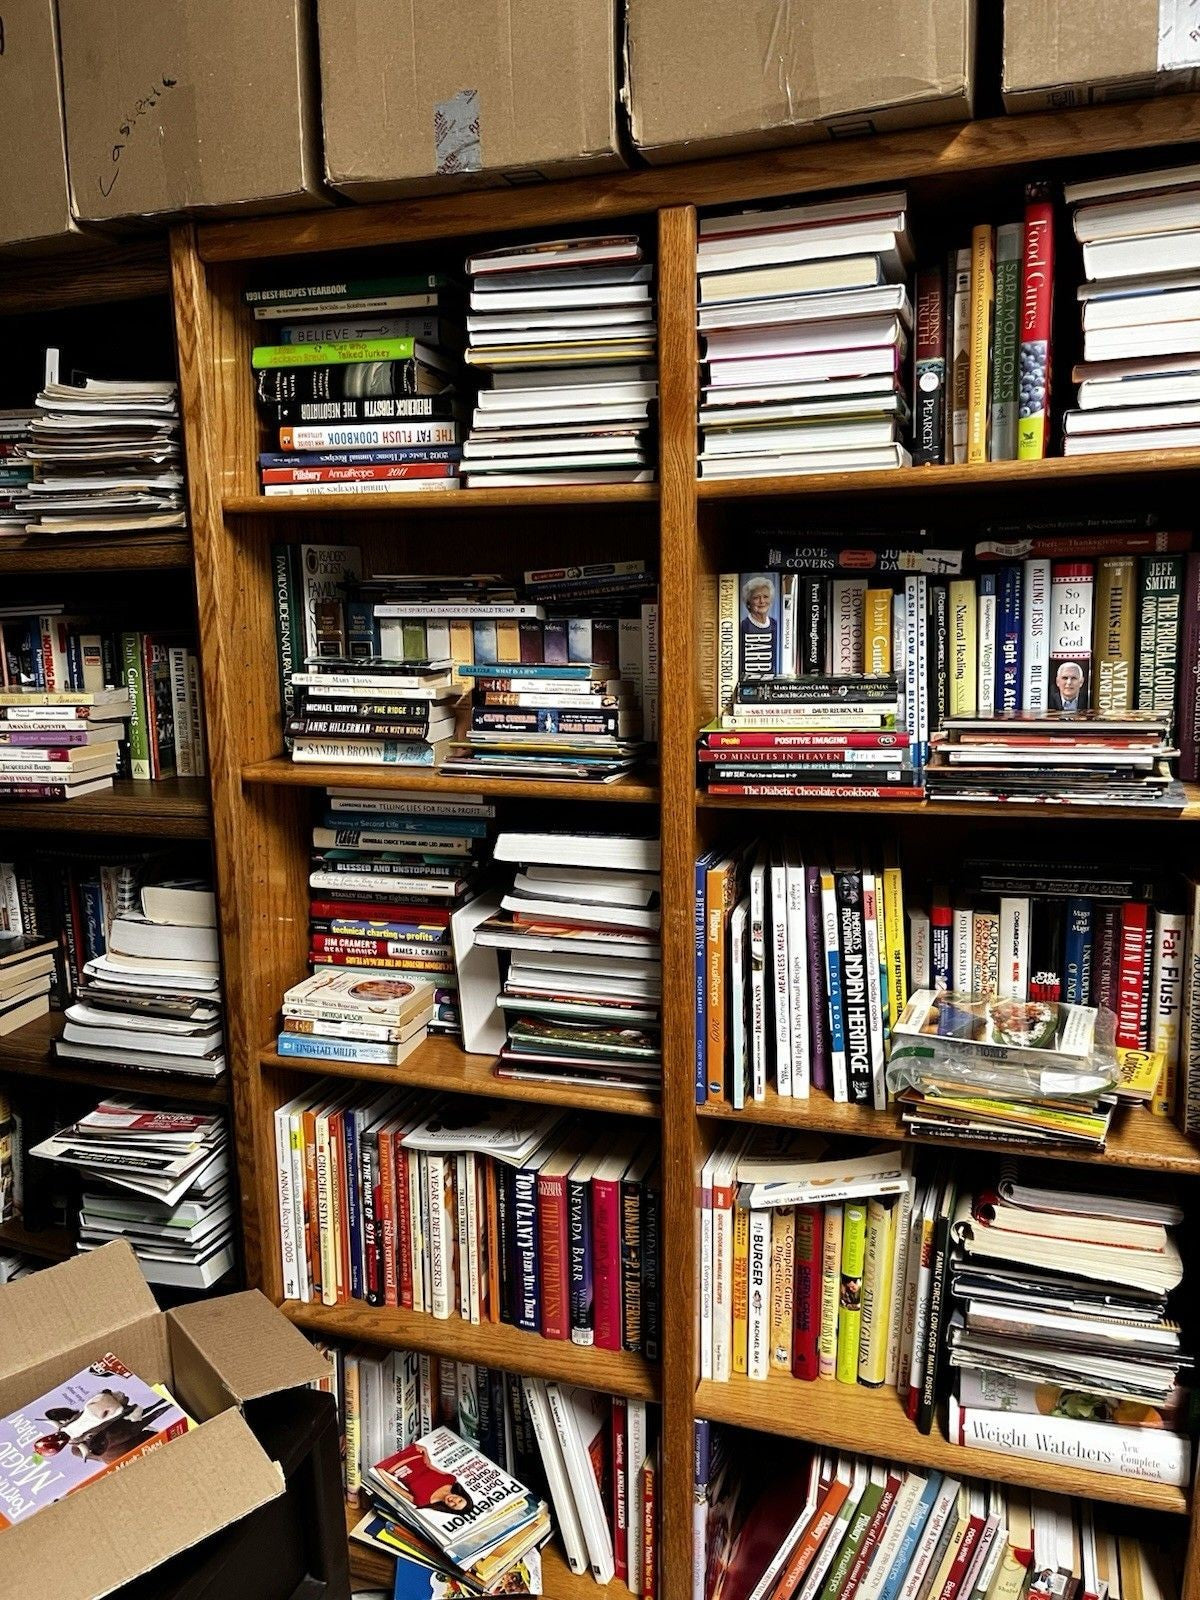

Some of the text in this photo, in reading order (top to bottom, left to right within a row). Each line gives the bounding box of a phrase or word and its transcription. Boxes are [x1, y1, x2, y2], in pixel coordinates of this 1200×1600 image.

[1024, 219, 1047, 330] Food Cures
[298, 329, 349, 341] BELIEVE
[917, 294, 930, 346] TRUTH
[929, 291, 940, 345] FINDING
[992, 265, 1004, 401] EVERYDAY FAMILY DINNERS
[1001, 263, 1018, 399] SARA MOULTON'S
[328, 428, 454, 445] THE FAT FLUSH COOKBOOK
[922, 398, 935, 451] PEARCEY
[786, 559, 835, 569] COVERS
[795, 548, 828, 558] LOVE
[1149, 562, 1173, 576] JEFF
[908, 586, 916, 618] CASH
[1031, 568, 1044, 637] KILLING JESUS
[1065, 589, 1079, 598] So
[1145, 576, 1176, 590] SMITH
[809, 584, 820, 664] Perri O'Shaughnessy
[840, 589, 851, 664] YOUR STOCK
[852, 588, 861, 641] HOW TO
[1059, 605, 1086, 617] Help
[1063, 621, 1080, 631] Me
[1108, 587, 1123, 657] JEFF SMITH
[43, 634, 54, 677] NOTHING
[908, 623, 916, 655] FLOW
[955, 605, 966, 680] Natural Healing
[1059, 637, 1083, 647] God
[1155, 595, 1179, 710] THE FRUGAL GOURM
[173, 651, 186, 703] BRAD TAYLOR
[908, 661, 916, 684] AND
[983, 644, 992, 701] Weight Loss
[308, 744, 382, 757] SANDRA BROWN
[775, 736, 847, 744] POSITIVE IMAGING
[744, 786, 880, 797] The Diabetic Chocolate Cookbook
[337, 863, 450, 875] BLESSED AND UNSTOPPABLE
[324, 938, 377, 949] JIM CRAMER'S
[696, 897, 704, 950] BETTE DAVIS
[827, 913, 836, 946] COLOR
[841, 908, 852, 954] FASCINATING
[851, 912, 861, 950] AMERICA'S
[776, 923, 786, 1042] Easy Dinners MEATLESS MEALS
[1119, 926, 1142, 1040] JOHN le CARRÉ
[845, 954, 869, 1074] INDIAN HERITAGE
[362, 1153, 374, 1245] IN THE WAKE OF 9/11
[431, 1173, 439, 1200] YEAR
[432, 1201, 440, 1214] OF
[280, 1169, 293, 1263] ANNUAL Recipes 2005
[433, 1216, 441, 1239] DIET
[459, 1208, 466, 1216] TO
[515, 1173, 537, 1251] TOM CLANCY
[571, 1185, 585, 1281] NEVADA BARR
[433, 1240, 442, 1287] DESSERTS
[541, 1201, 560, 1318] THE LAST PRINCESS
[646, 1207, 656, 1288] NEVADA BARR
[752, 1234, 763, 1286] BURGER
[826, 1241, 836, 1254] THE
[824, 1255, 835, 1285] WOMAN'S
[579, 1288, 587, 1324] WINTER
[823, 1286, 834, 1298] DAY
[904, 1281, 916, 1335] Comfort Food
[822, 1338, 832, 1354] PLAN
[923, 1251, 944, 1405] FAMILY CIRCLE LOW-COST MAIN DISHES
[10, 1413, 44, 1448] FARM
[973, 1420, 1112, 1463] Weight Watchers
[1120, 1465, 1162, 1479] Cookbook
[1121, 1454, 1160, 1469] Complete
[442, 1480, 522, 1533] Prevention
[617, 1469, 626, 1529] ANNUAL RECIPES
[942, 1581, 955, 1597] Best
